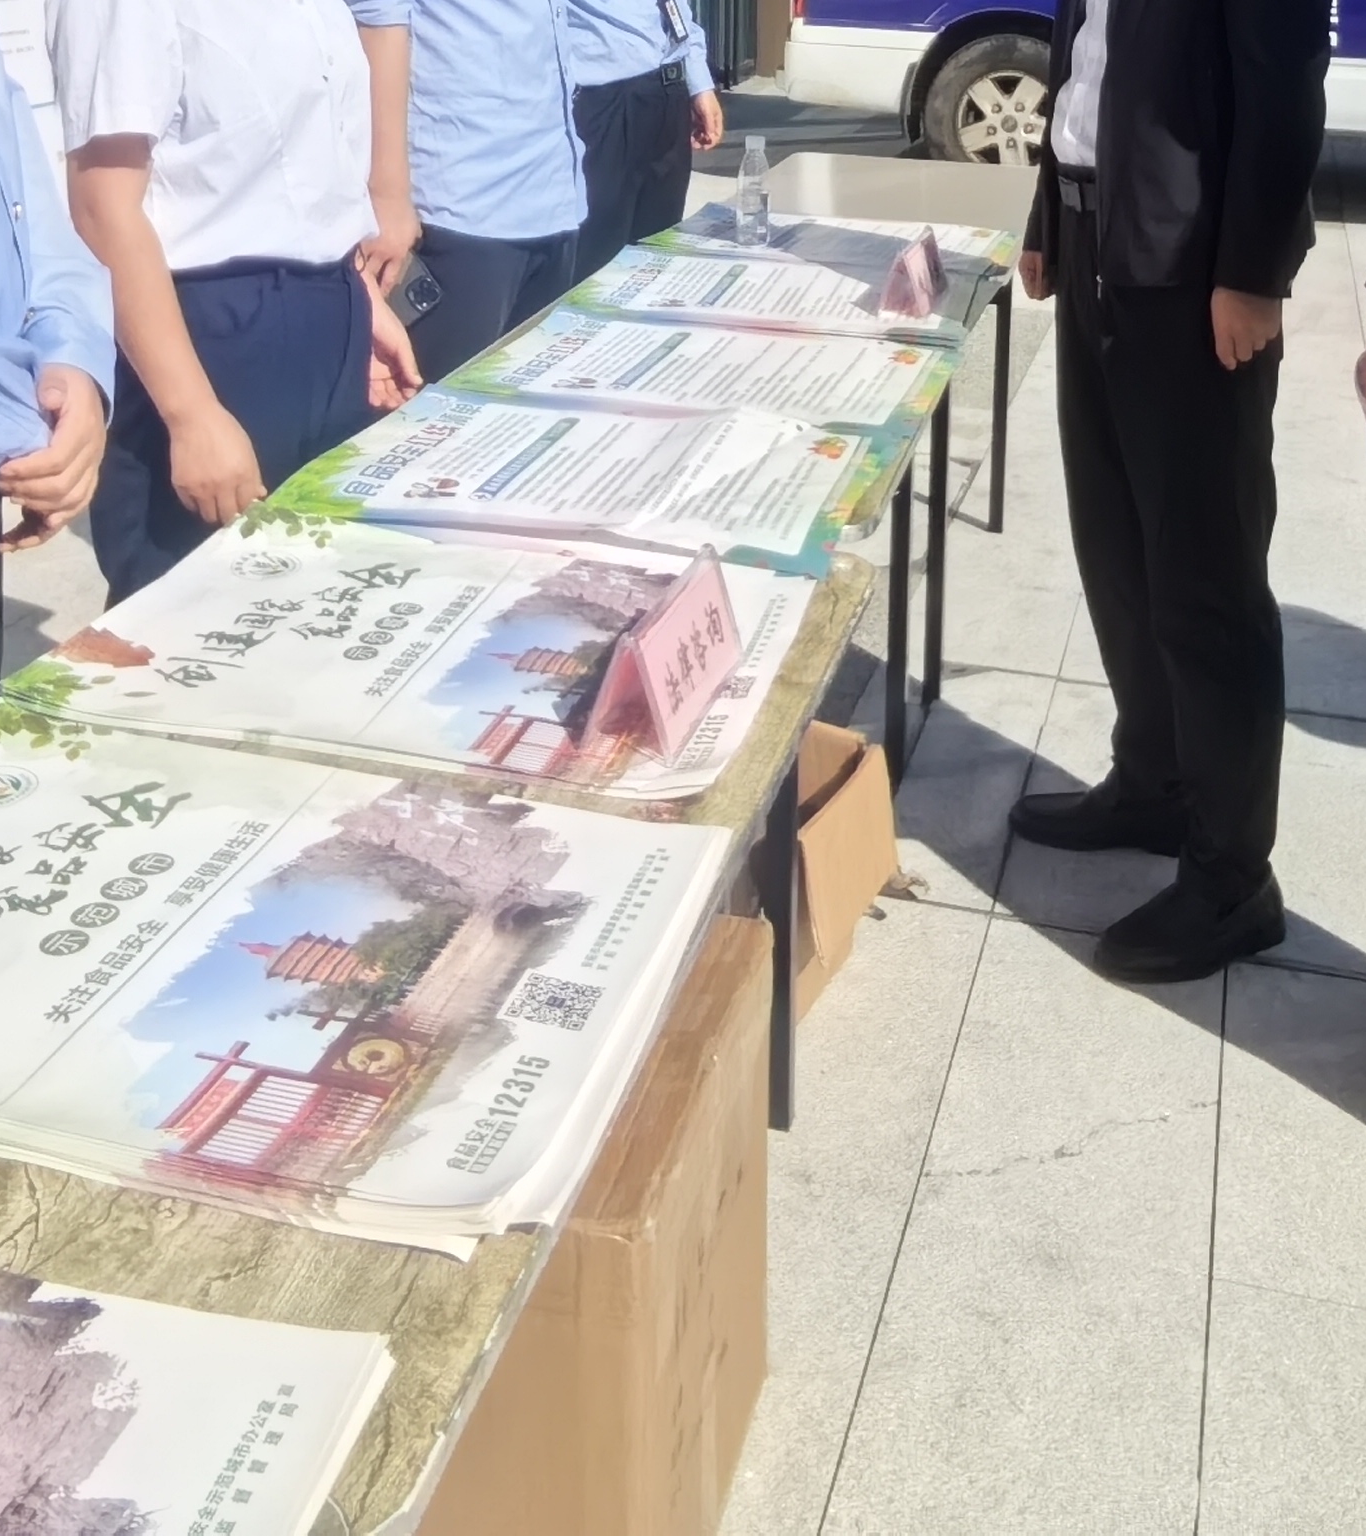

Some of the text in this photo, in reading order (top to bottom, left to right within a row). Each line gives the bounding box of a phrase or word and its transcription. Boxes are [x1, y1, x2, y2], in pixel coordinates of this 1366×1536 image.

[43, 820, 271, 1024] 关注食品安全 享受健康生活
[488, 1054, 551, 1118] 12315
